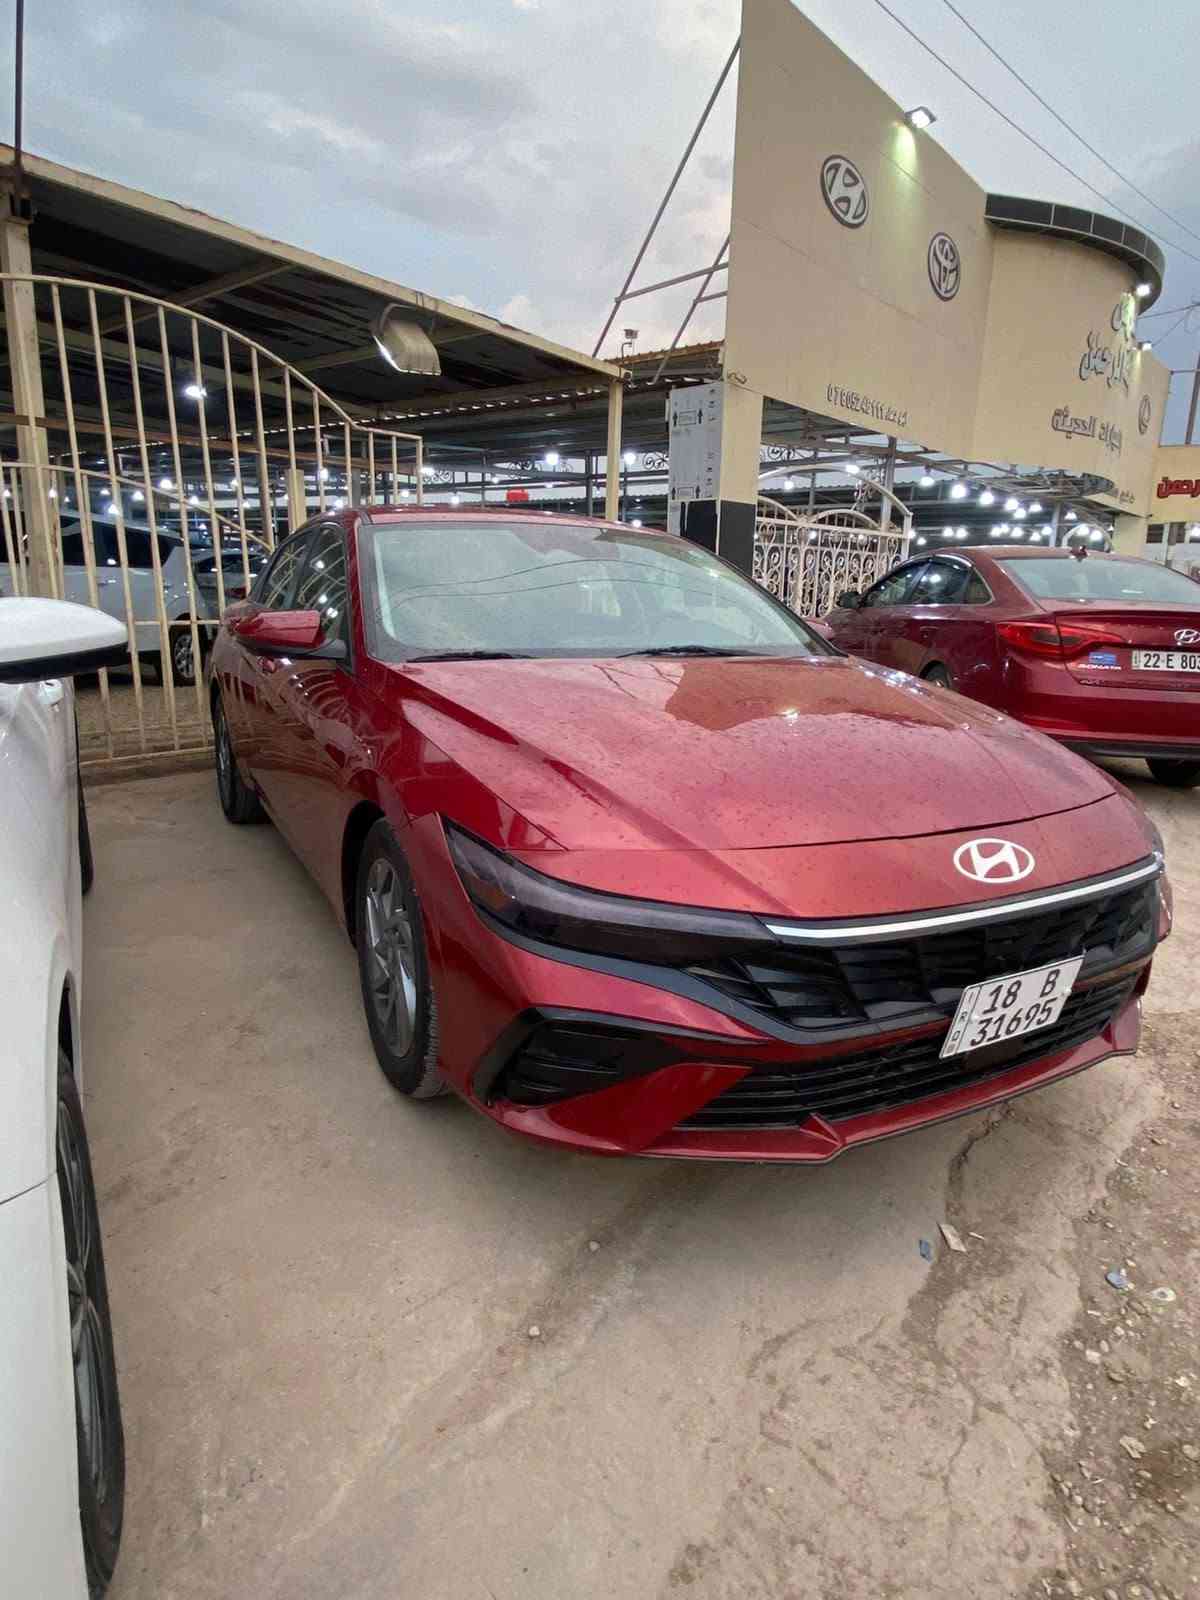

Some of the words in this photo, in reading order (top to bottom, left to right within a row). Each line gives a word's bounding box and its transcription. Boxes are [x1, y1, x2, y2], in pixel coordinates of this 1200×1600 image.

[1143, 652, 1161, 669] 22
[1166, 653, 1175, 669] E
[982, 979, 1022, 1015] 18
[1039, 968, 1061, 999] B
[969, 996, 1058, 1047] 31695
